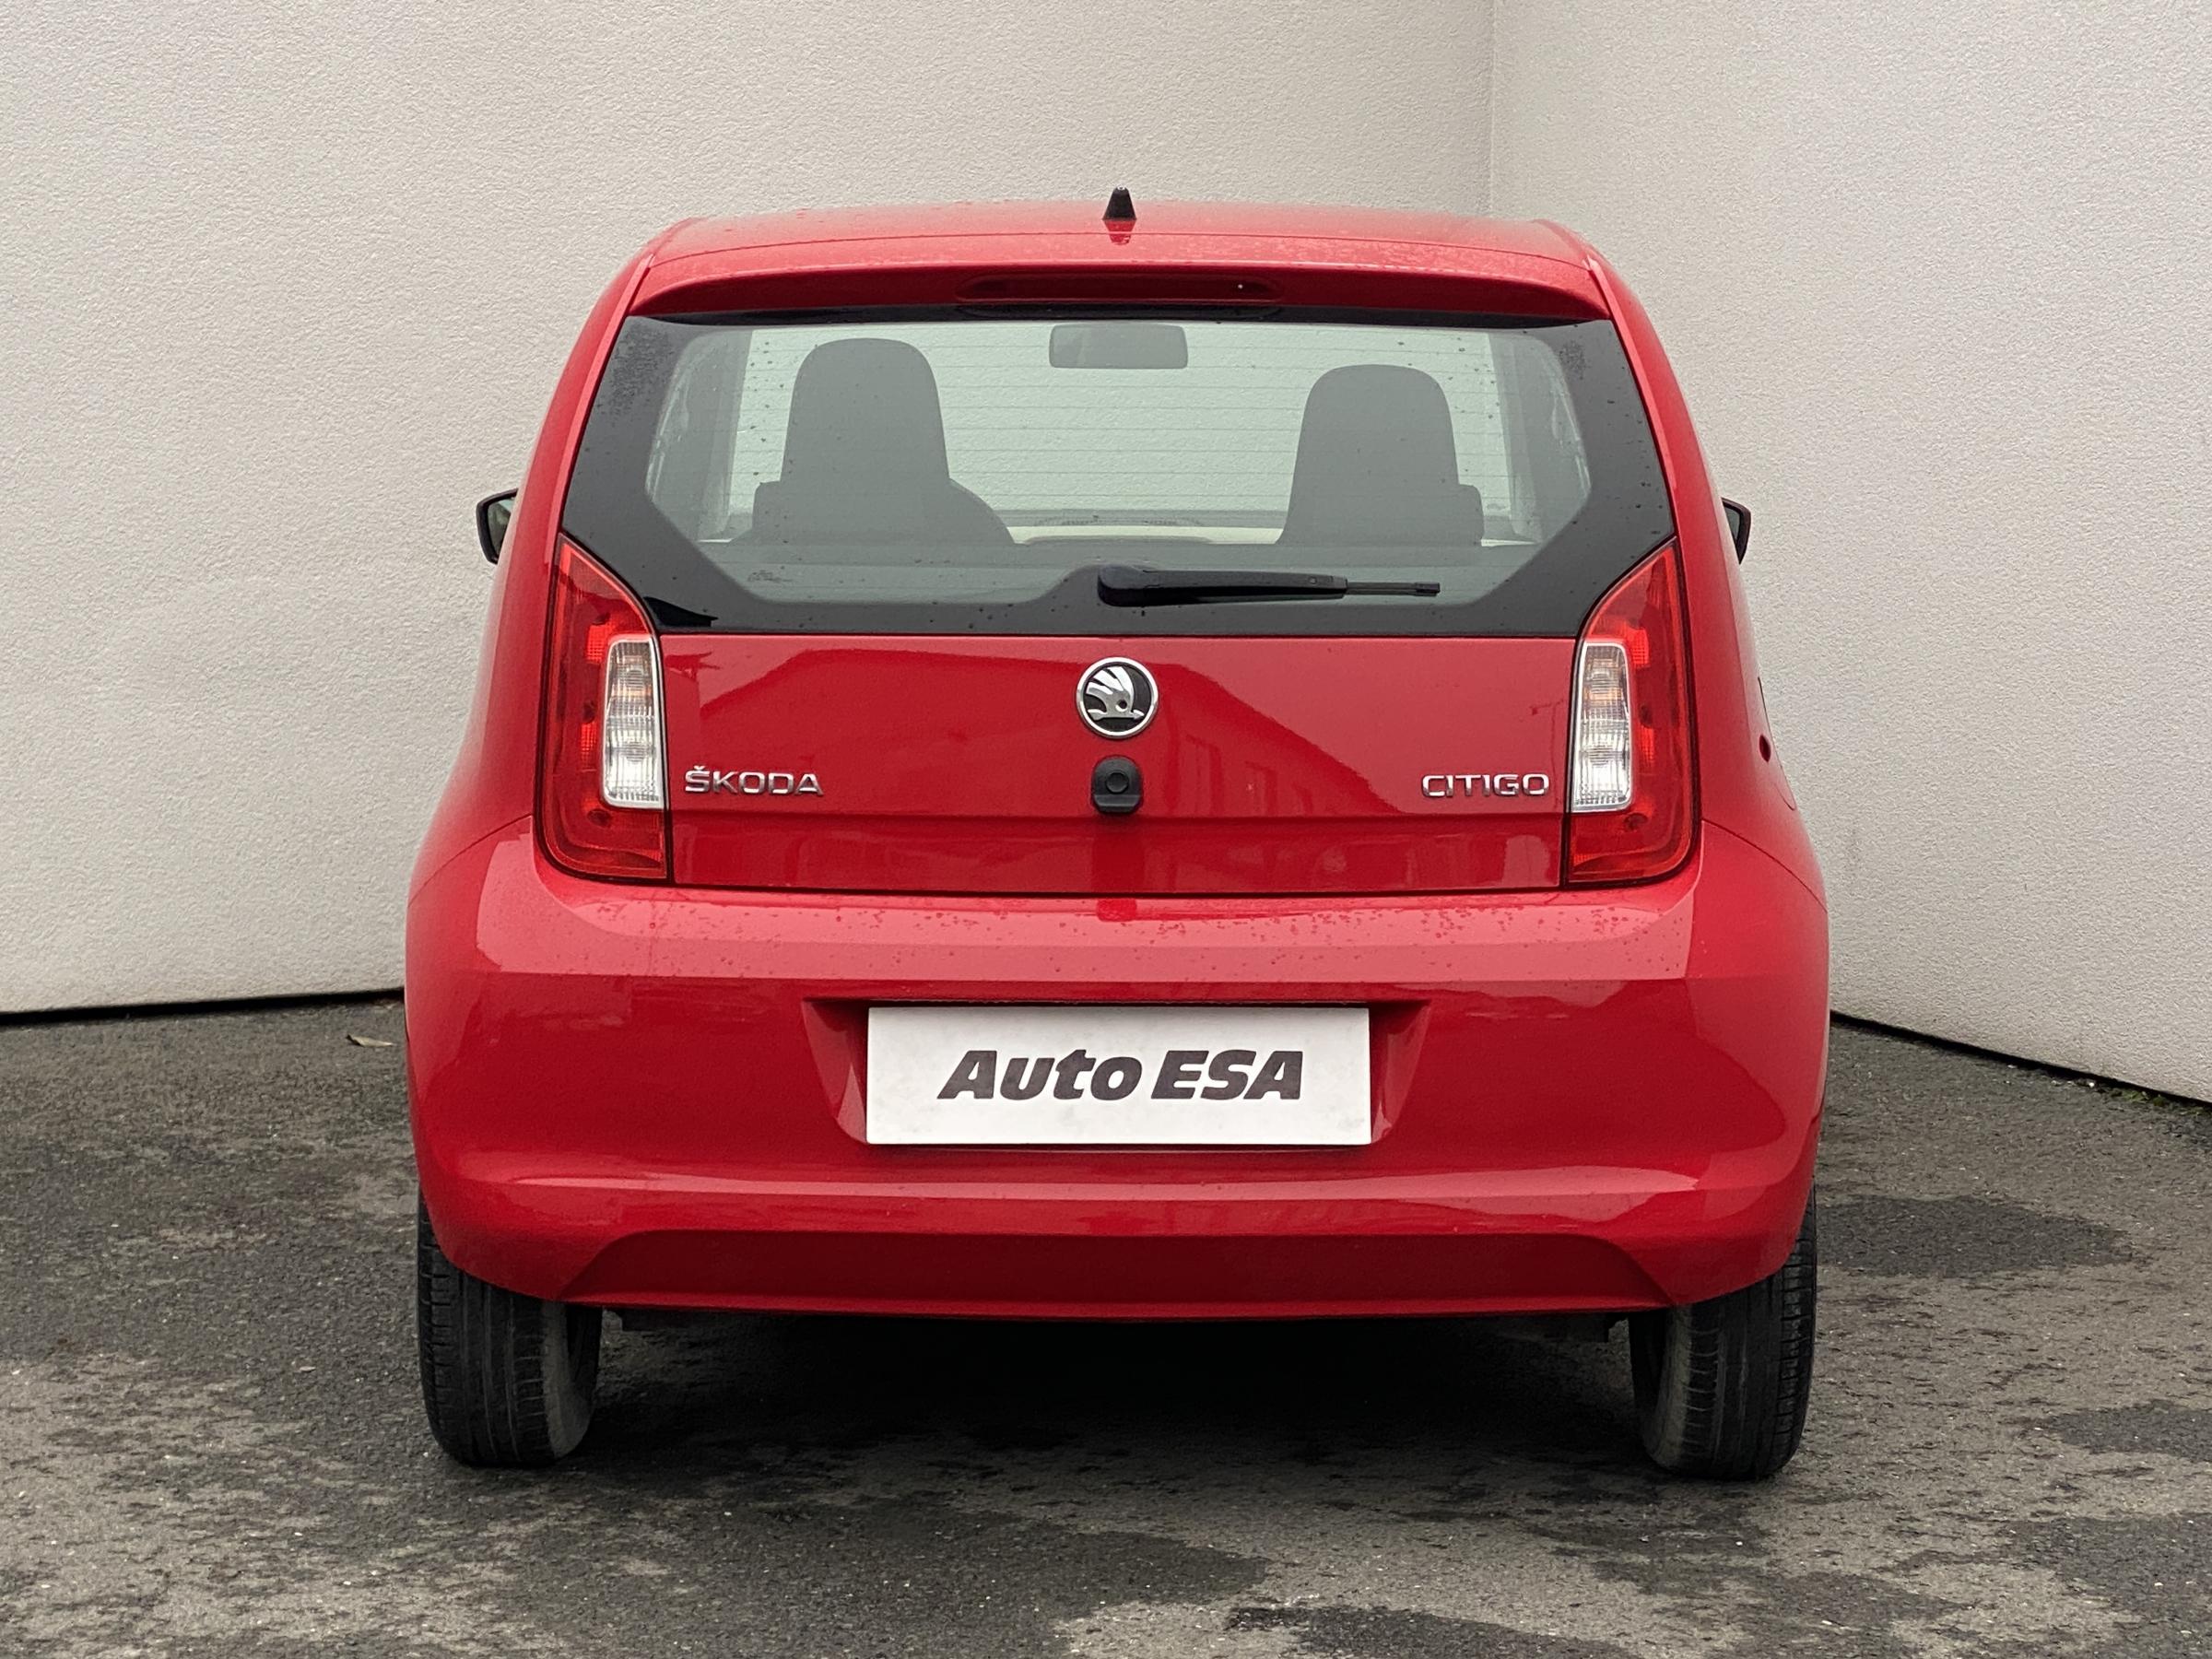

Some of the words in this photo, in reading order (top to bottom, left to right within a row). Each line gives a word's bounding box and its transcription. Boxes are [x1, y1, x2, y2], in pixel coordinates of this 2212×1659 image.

[685, 765, 824, 796] ŠKODA
[1422, 773, 1550, 798] CITIGO
[936, 1048, 1143, 1100] Auto
[1150, 1049, 1304, 1100] ESA
